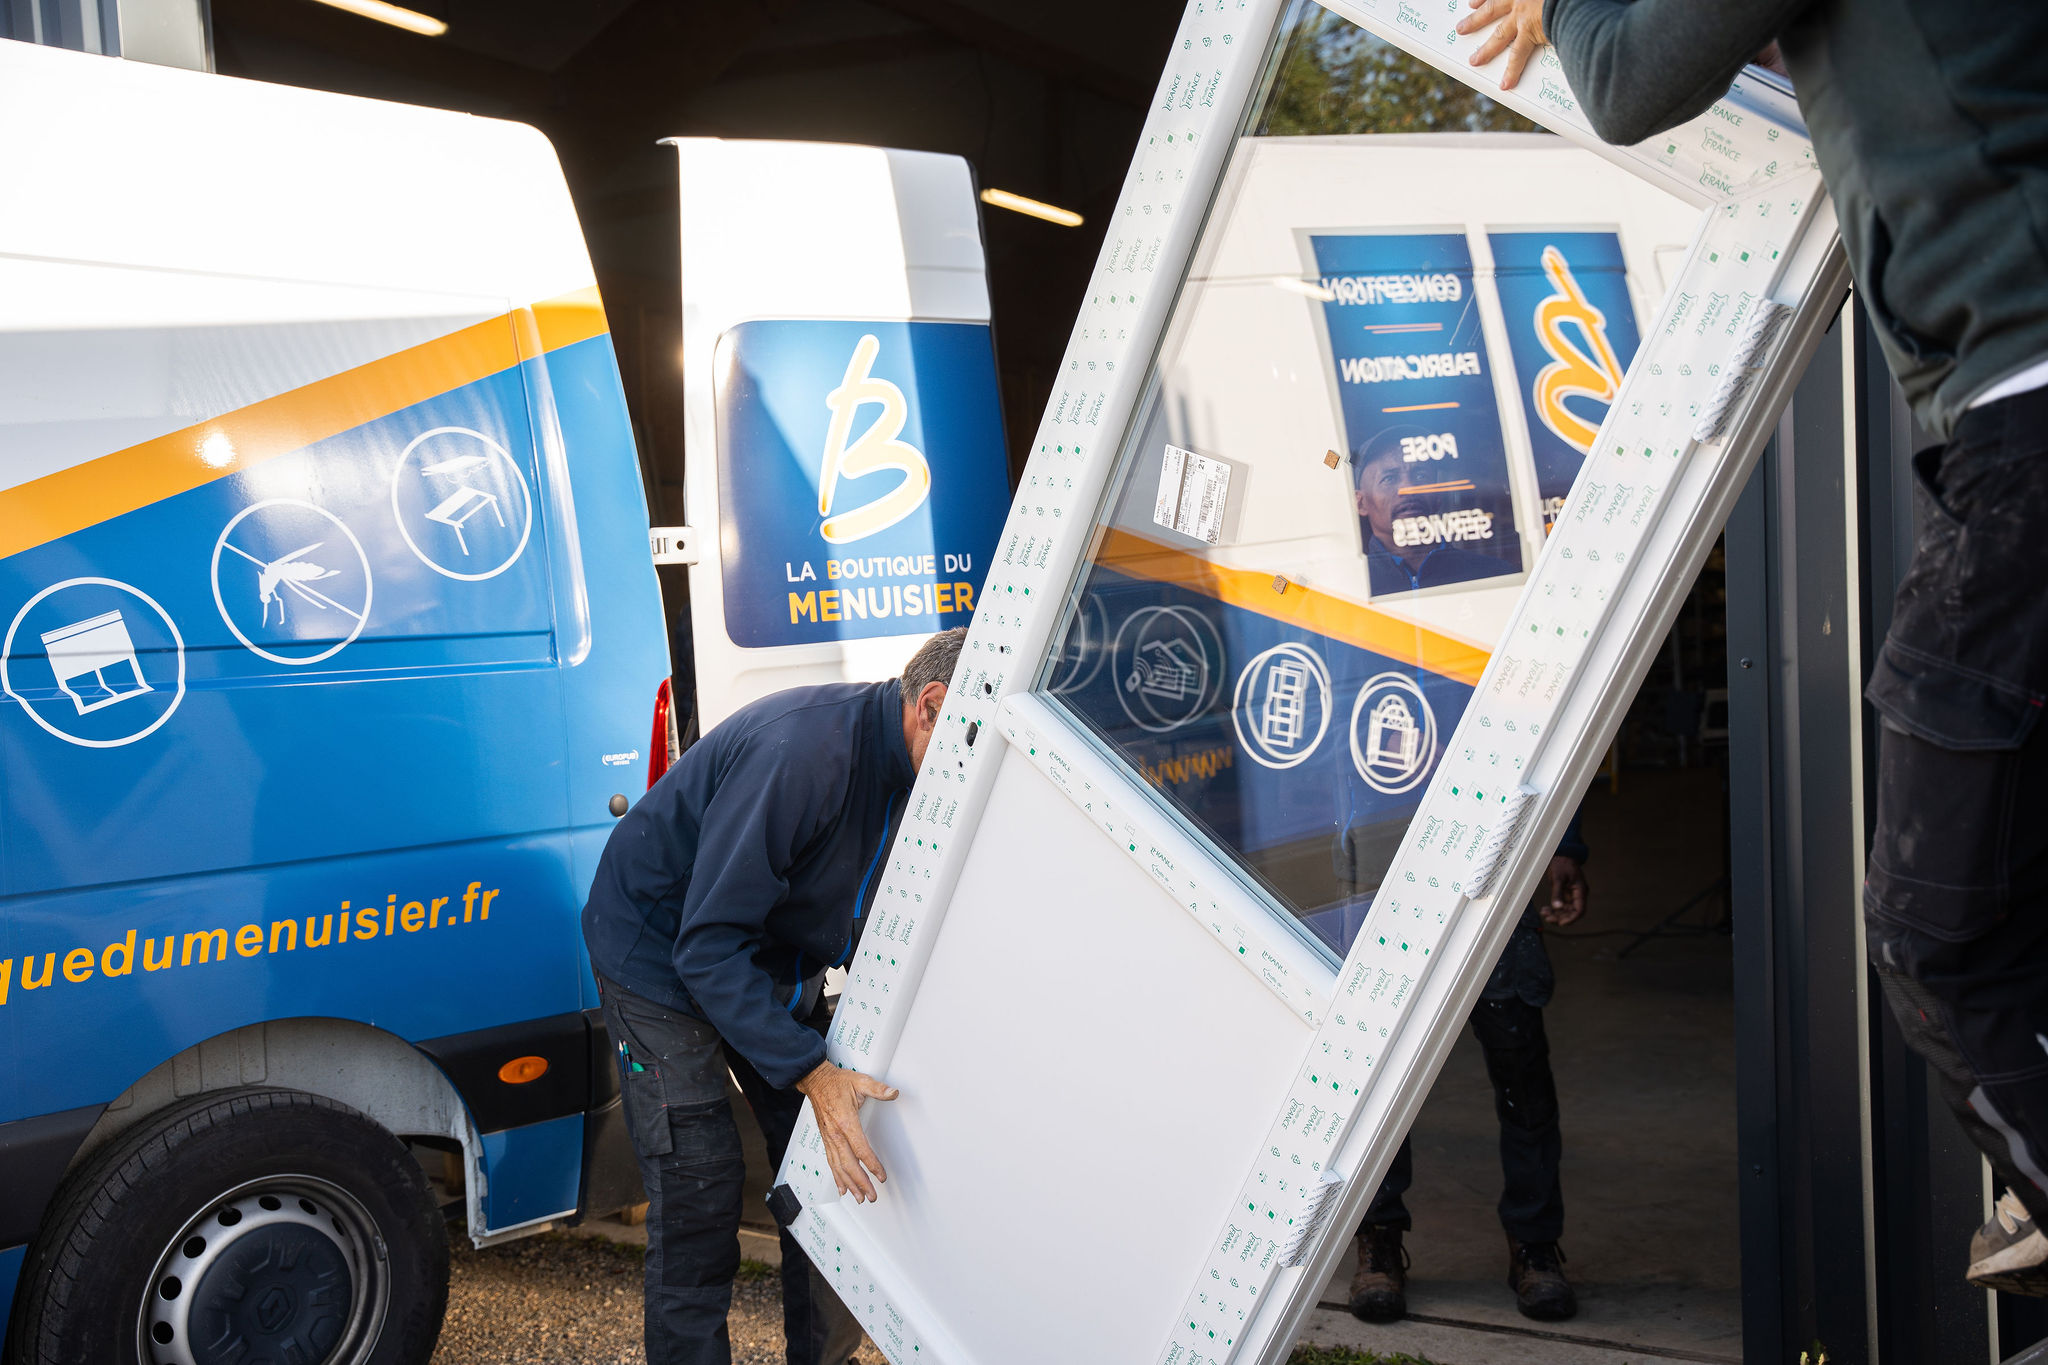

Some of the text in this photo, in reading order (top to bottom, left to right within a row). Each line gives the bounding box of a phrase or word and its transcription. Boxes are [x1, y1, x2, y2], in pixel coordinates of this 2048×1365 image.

[1400, 12, 1428, 32] FRANCE
[1166, 74, 1181, 107] FRANCE
[1186, 72, 1201, 105] FRANCE
[1205, 69, 1221, 104] FRANCE
[1542, 89, 1574, 111] FRANCE
[1705, 138, 1741, 162] FRANCE
[1106, 238, 1123, 271] FRANCE
[1126, 236, 1143, 269] FRANCE
[1147, 236, 1161, 269] FRANCE
[1665, 297, 1689, 336] FRANCE
[1695, 296, 1719, 336] FRANCE
[1725, 296, 1750, 336] FRANCE
[1055, 390, 1069, 420] FRANCE
[1071, 392, 1087, 421] FRANCE
[1089, 392, 1105, 423] FRANCE
[818, 334, 931, 545] B
[1576, 486, 1597, 522] FRANCE
[1602, 488, 1624, 525] FRANCE
[1630, 489, 1654, 527] FRANCE
[1004, 533, 1019, 562] FRANCE
[1022, 536, 1036, 563] FRANCE
[1039, 537, 1053, 565] FRANCE
[786, 553, 972, 583] LA BOUTIQUE DU
[788, 581, 976, 625] MENUISIER
[957, 667, 971, 693] FRANCE
[973, 670, 987, 698] FRANCE
[989, 673, 1003, 700] FRANCE
[1493, 660, 1514, 694] FRANCE
[1518, 663, 1539, 697] FRANCE
[1544, 667, 1565, 702] FRANCE
[913, 792, 927, 817] FRANCE
[928, 796, 943, 821] FRANCE
[944, 800, 958, 826] FRANCE
[1418, 819, 1436, 851] FRANCE
[1441, 824, 1460, 856] FRANCE
[1465, 829, 1484, 861] FRANCE
[1347, 966, 1364, 996] FRANCE
[1369, 972, 1387, 1002] FRANCE
[1391, 978, 1411, 1008] FRANCE
[1282, 1102, 1300, 1129] FRANCE
[1302, 1109, 1319, 1137] FRANCE
[1323, 1116, 1342, 1144] FRANCE
[1221, 1227, 1238, 1254] FRANCE
[1240, 1236, 1257, 1262] FRANCE
[1260, 1244, 1277, 1270] FRANCE
